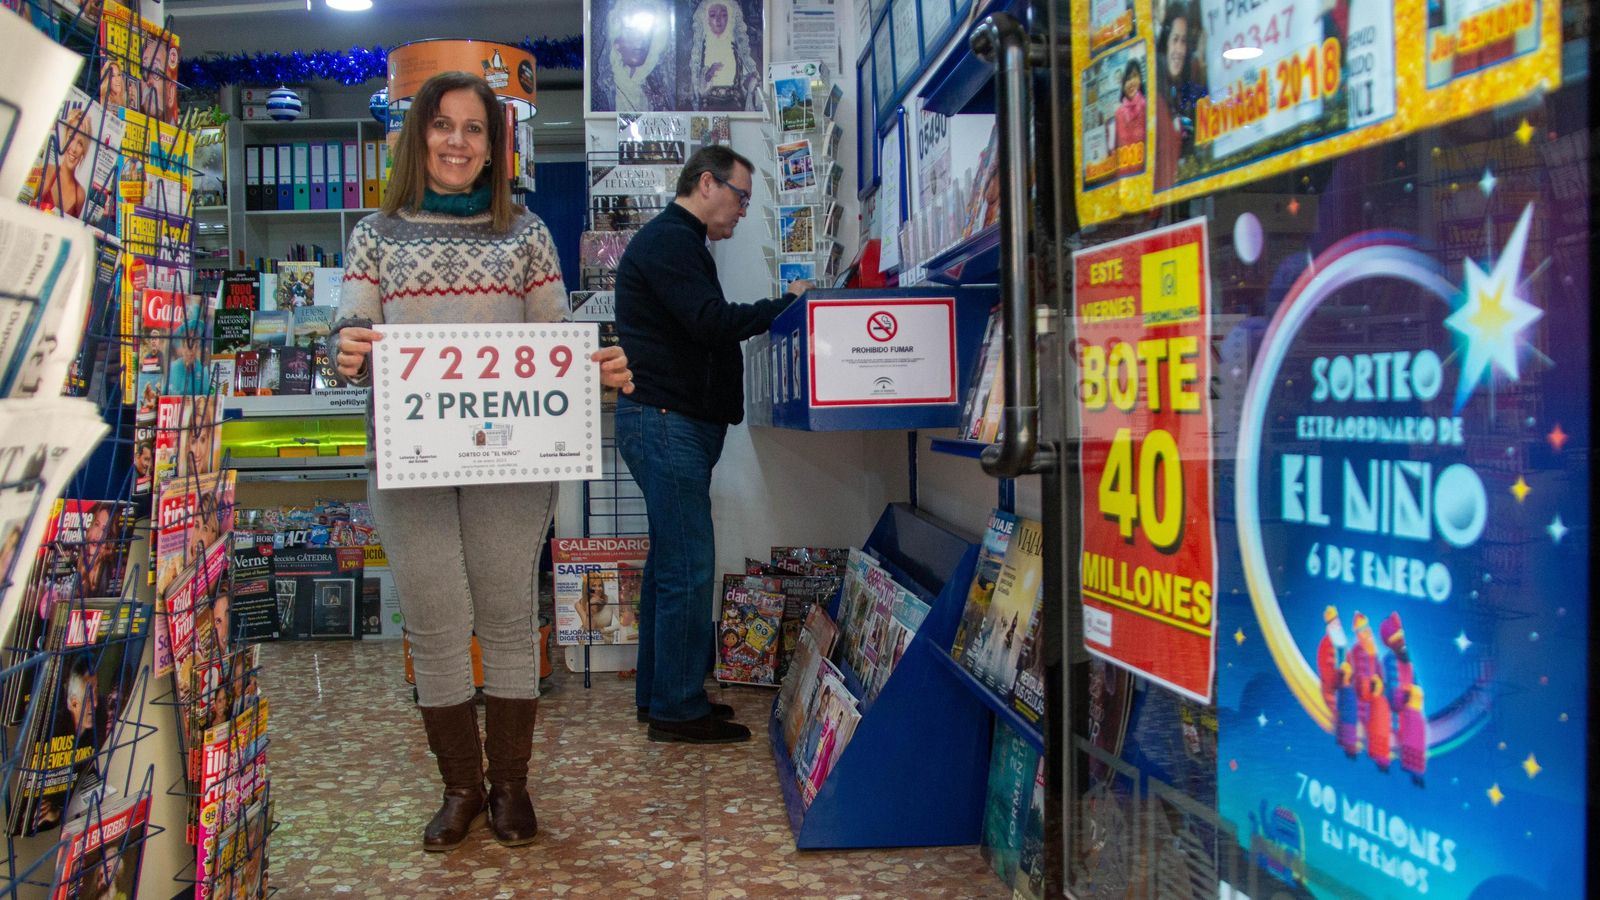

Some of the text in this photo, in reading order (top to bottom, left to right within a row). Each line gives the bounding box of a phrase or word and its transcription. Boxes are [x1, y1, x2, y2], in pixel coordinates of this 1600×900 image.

[1195, 37, 1342, 146] Navidad 2018
[1090, 257, 1124, 286] ESTE
[1081, 296, 1136, 325] VIERNES
[400, 345, 573, 381] 72289
[1083, 335, 1202, 413] BOTE
[1311, 349, 1443, 402] SORTEO
[438, 390, 569, 419] PREMIO
[1297, 415, 1464, 446] EXTRAORDINARIO DE
[1099, 427, 1185, 555] 40
[1281, 454, 1331, 526] EL
[235, 553, 269, 569] Verne
[296, 552, 332, 562] CÁTEDRA
[558, 564, 603, 575] SABER
[1306, 541, 1452, 602] 6 DE ENERO
[1083, 551, 1212, 626] MILLONES
[51, 735, 74, 752] NOUS
[1295, 772, 1457, 874] 700 MILLONES
[1321, 819, 1430, 895] EN PREMIOS
